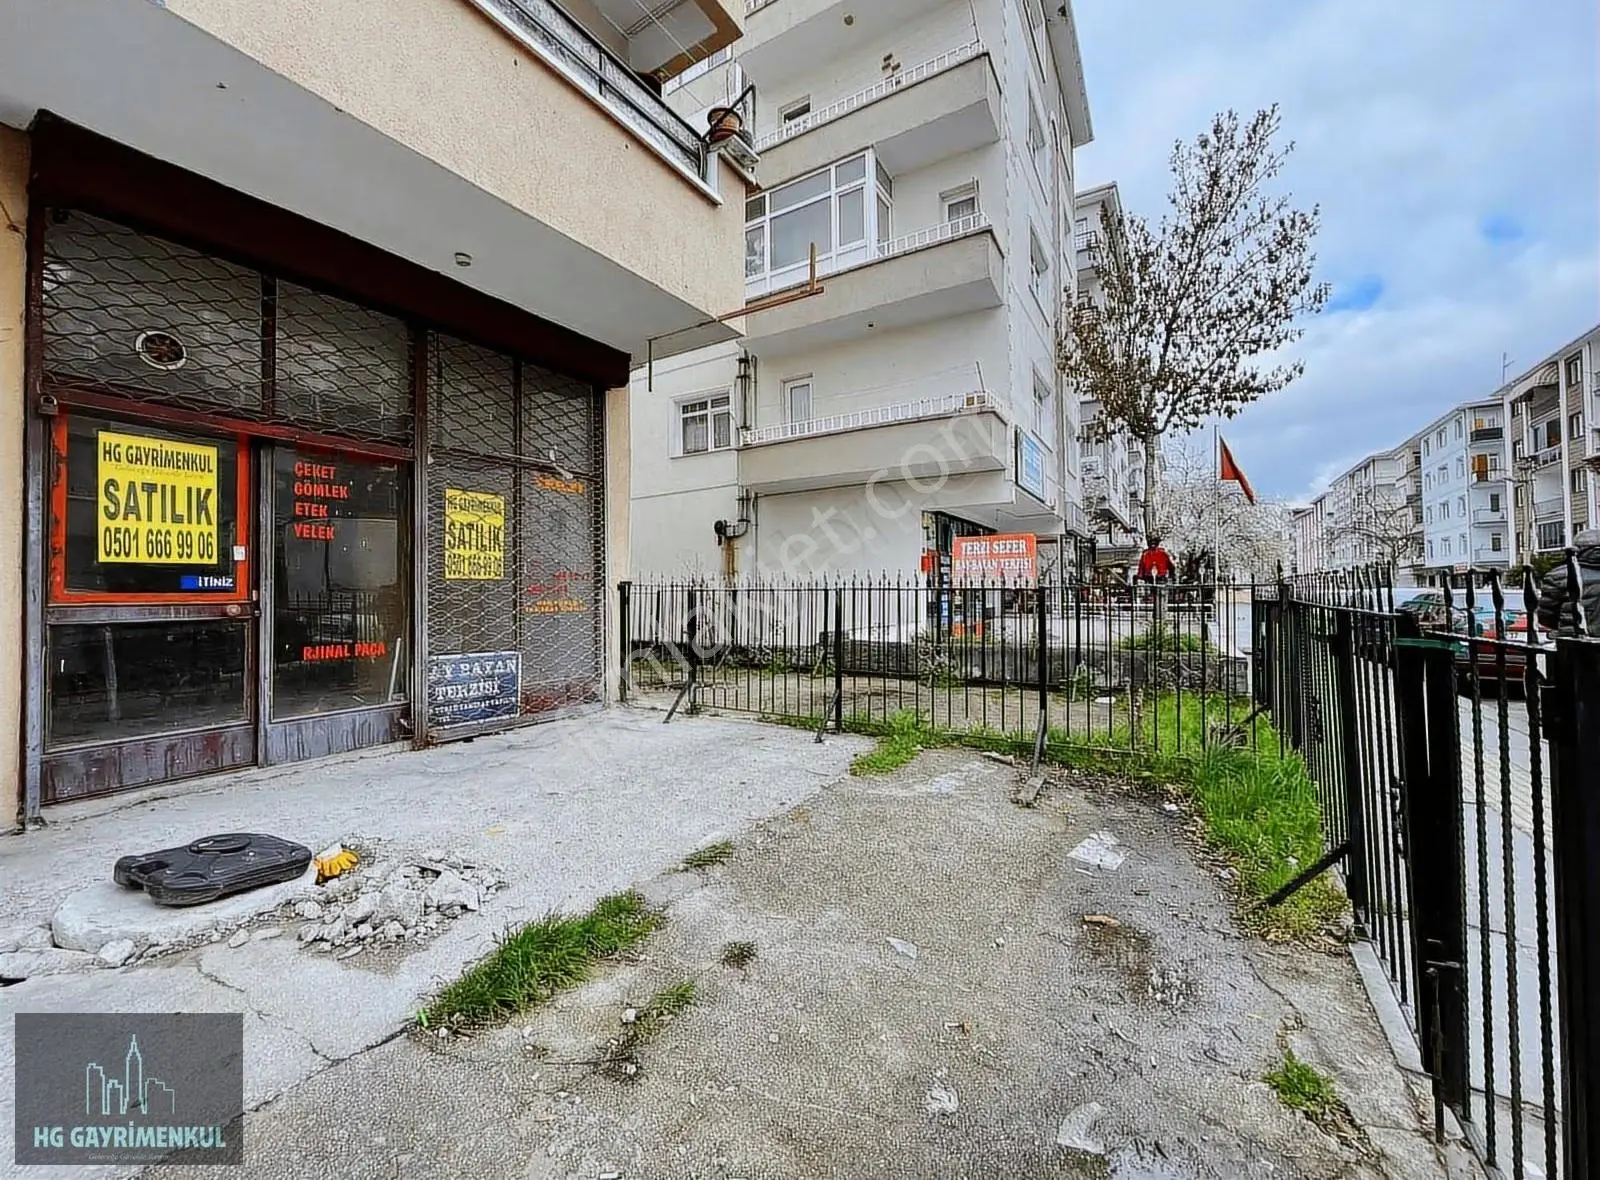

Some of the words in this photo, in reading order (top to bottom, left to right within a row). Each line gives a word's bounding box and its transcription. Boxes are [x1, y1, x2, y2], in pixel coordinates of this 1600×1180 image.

[103, 442, 121, 463] HG
[126, 444, 213, 473] GAYRİMENKUL
[104, 478, 213, 526] SATILIK
[295, 502, 328, 517] ETEK
[104, 526, 139, 558] 0501
[146, 528, 171, 559] 666
[177, 530, 193, 559] 99
[198, 531, 213, 560] 06
[448, 521, 501, 552] SATILIK
[992, 540, 1026, 553] SEFER
[428, 664, 455, 681] AY
[460, 660, 517, 676] BAYAN
